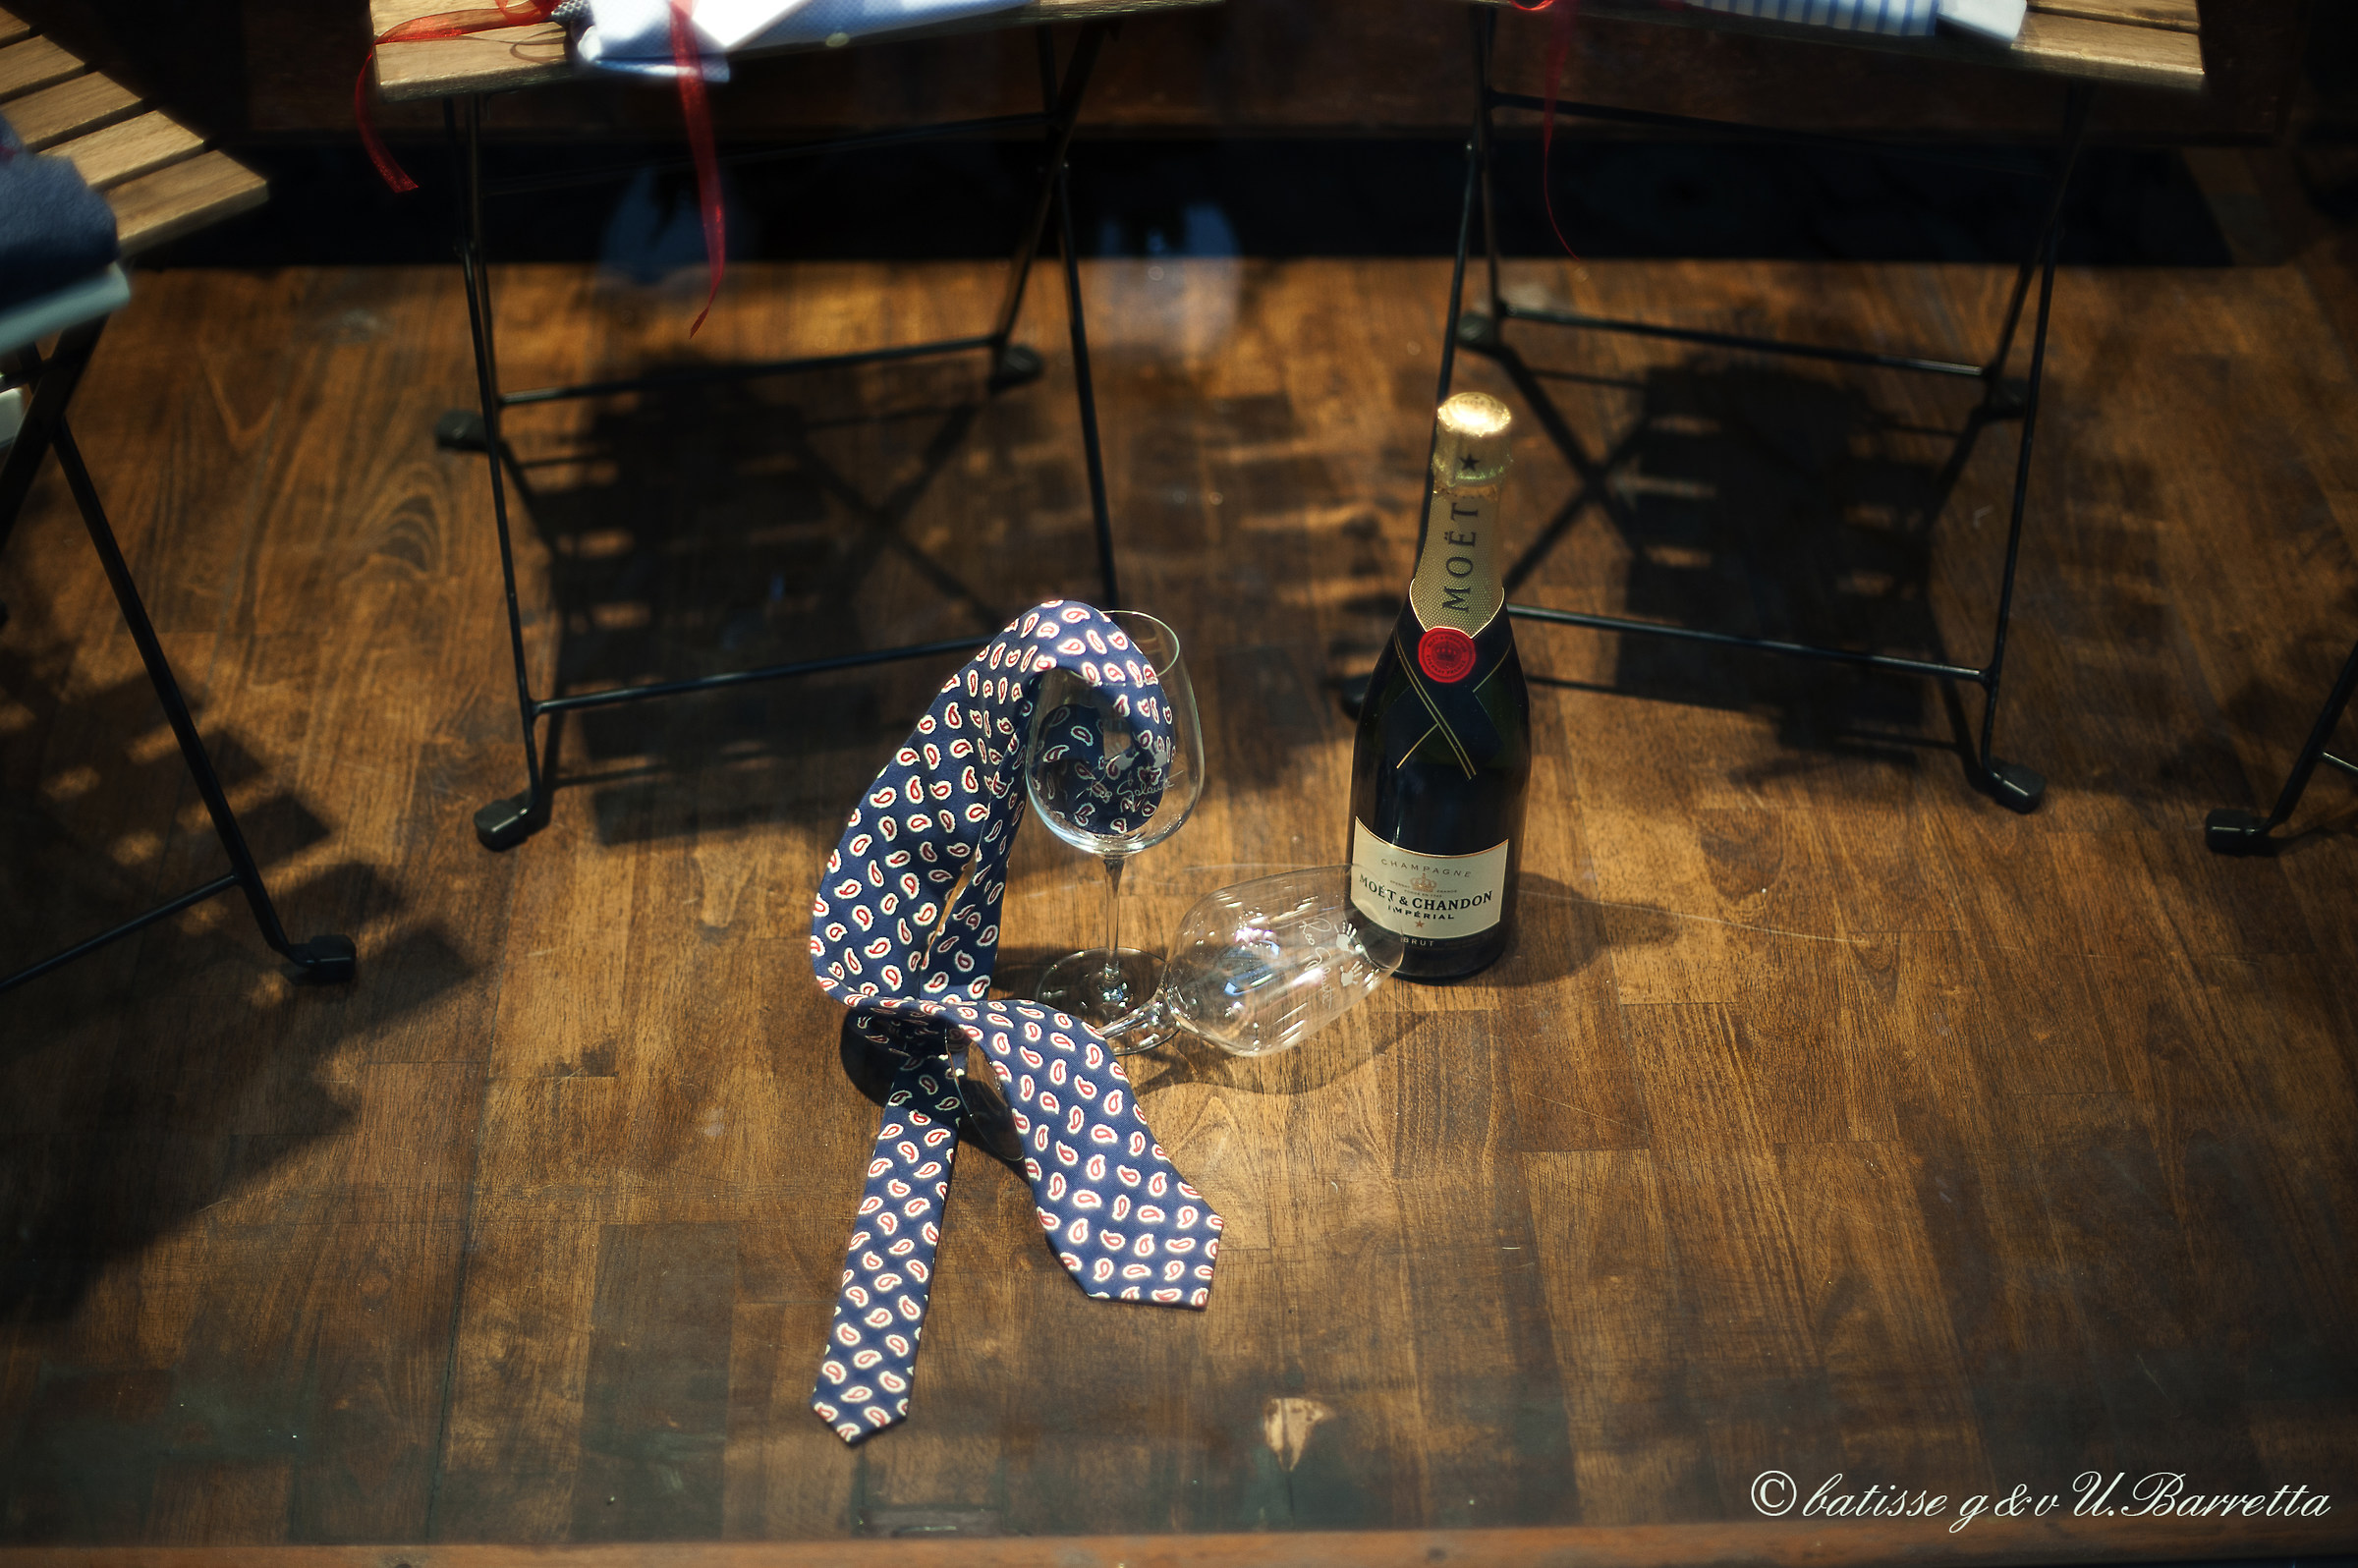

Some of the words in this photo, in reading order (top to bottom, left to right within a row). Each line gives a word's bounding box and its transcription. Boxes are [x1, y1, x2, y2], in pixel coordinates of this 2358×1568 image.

[1441, 501, 1480, 613] MOËT
[1380, 858, 1473, 878] CHAMPAGNE
[1359, 872, 1397, 902] MOËT
[1398, 895, 1409, 907] &
[1412, 890, 1493, 911] CHANDON
[1387, 905, 1455, 920] IMPÉRIAL
[1401, 936, 1435, 947] BRUT
